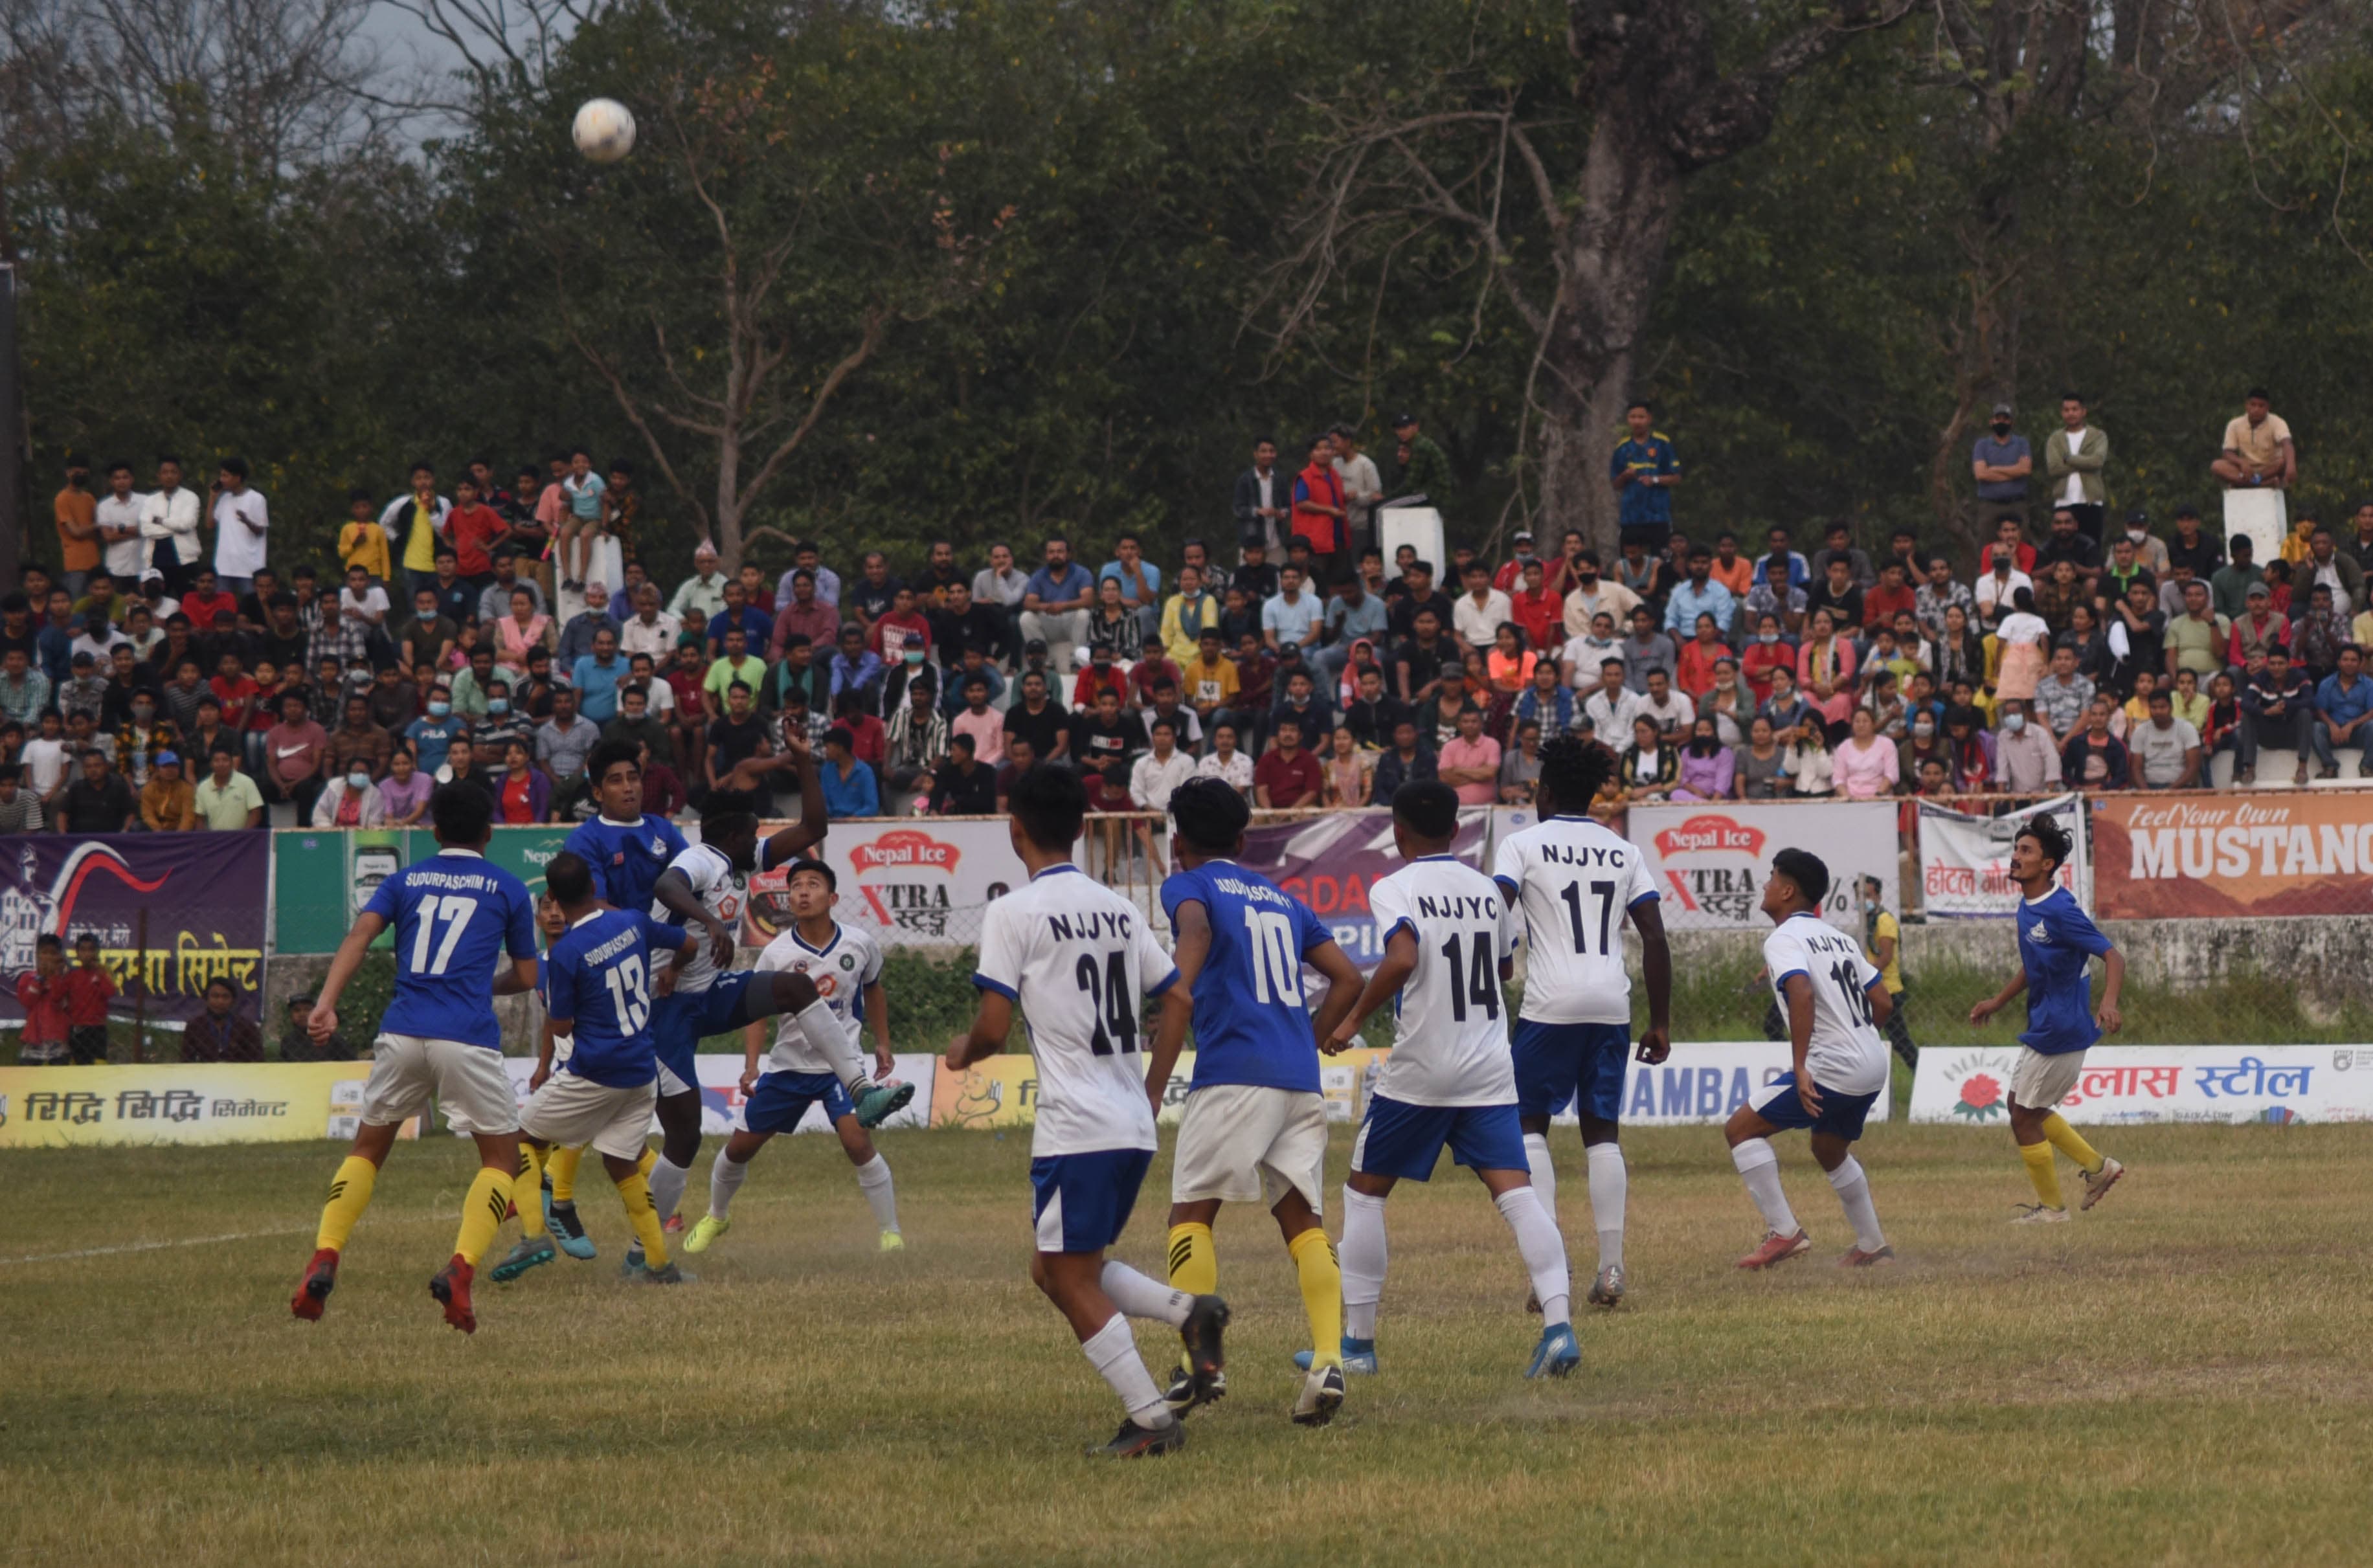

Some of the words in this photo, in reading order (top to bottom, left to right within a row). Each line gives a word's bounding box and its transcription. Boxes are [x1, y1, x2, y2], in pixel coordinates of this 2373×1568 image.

[2128, 803, 2178, 828] Feel
[2176, 803, 2229, 828] Your
[2234, 802, 2290, 824] Own
[863, 845, 912, 866] Nepal
[919, 846, 946, 863] Ice
[1542, 844, 1625, 868] NJJYC
[1669, 831, 1717, 851] Nepal
[1724, 831, 1751, 846] Ice
[405, 872, 484, 890] SUDURPASCHIM
[486, 878, 498, 895] 11
[859, 883, 950, 926] XTRA
[1665, 868, 1755, 912] XTRA
[1048, 912, 1131, 942] NJJYC
[1418, 896, 1497, 920] NJJYC
[1561, 880, 1615, 956] 17
[410, 893, 478, 974] 17
[1245, 905, 1301, 1007] 10
[1441, 932, 1499, 1022] 14
[605, 954, 650, 1037] 13
[1076, 950, 1138, 1057] 24
[1620, 1067, 1750, 1116] AMBA
[2195, 1056, 2315, 1098] स्टील
